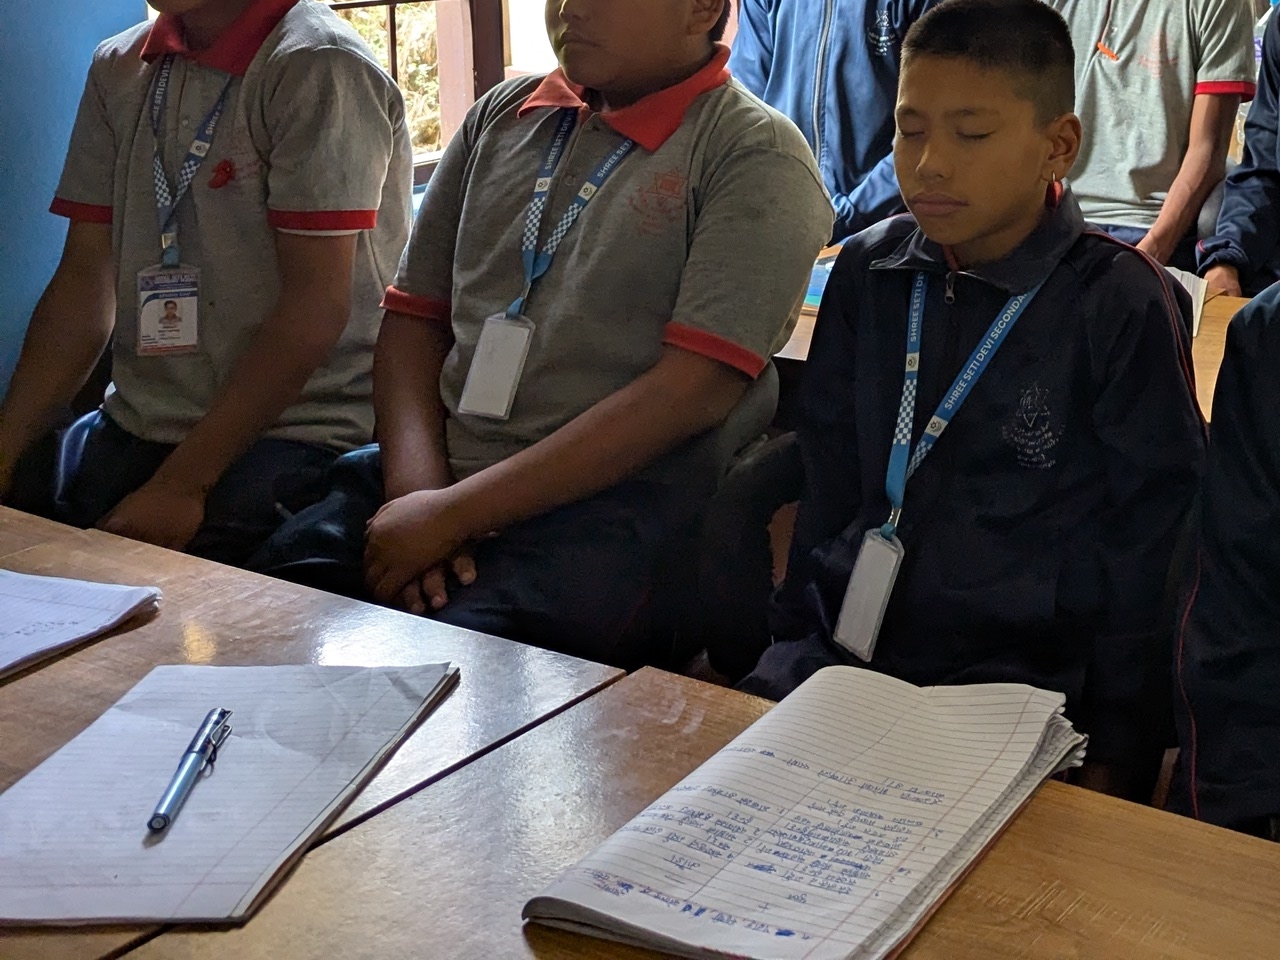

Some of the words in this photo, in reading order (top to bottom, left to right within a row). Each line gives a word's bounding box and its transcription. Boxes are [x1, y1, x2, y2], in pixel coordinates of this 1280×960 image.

[545, 147, 558, 170] SHREE
[554, 132, 564, 146] SETI
[597, 154, 617, 178] SHREE
[913, 289, 922, 310] SETI
[910, 312, 920, 342] SHREE
[944, 377, 968, 411] SHREE
[963, 355, 980, 381] SETI
[976, 338, 996, 362] DEVI
